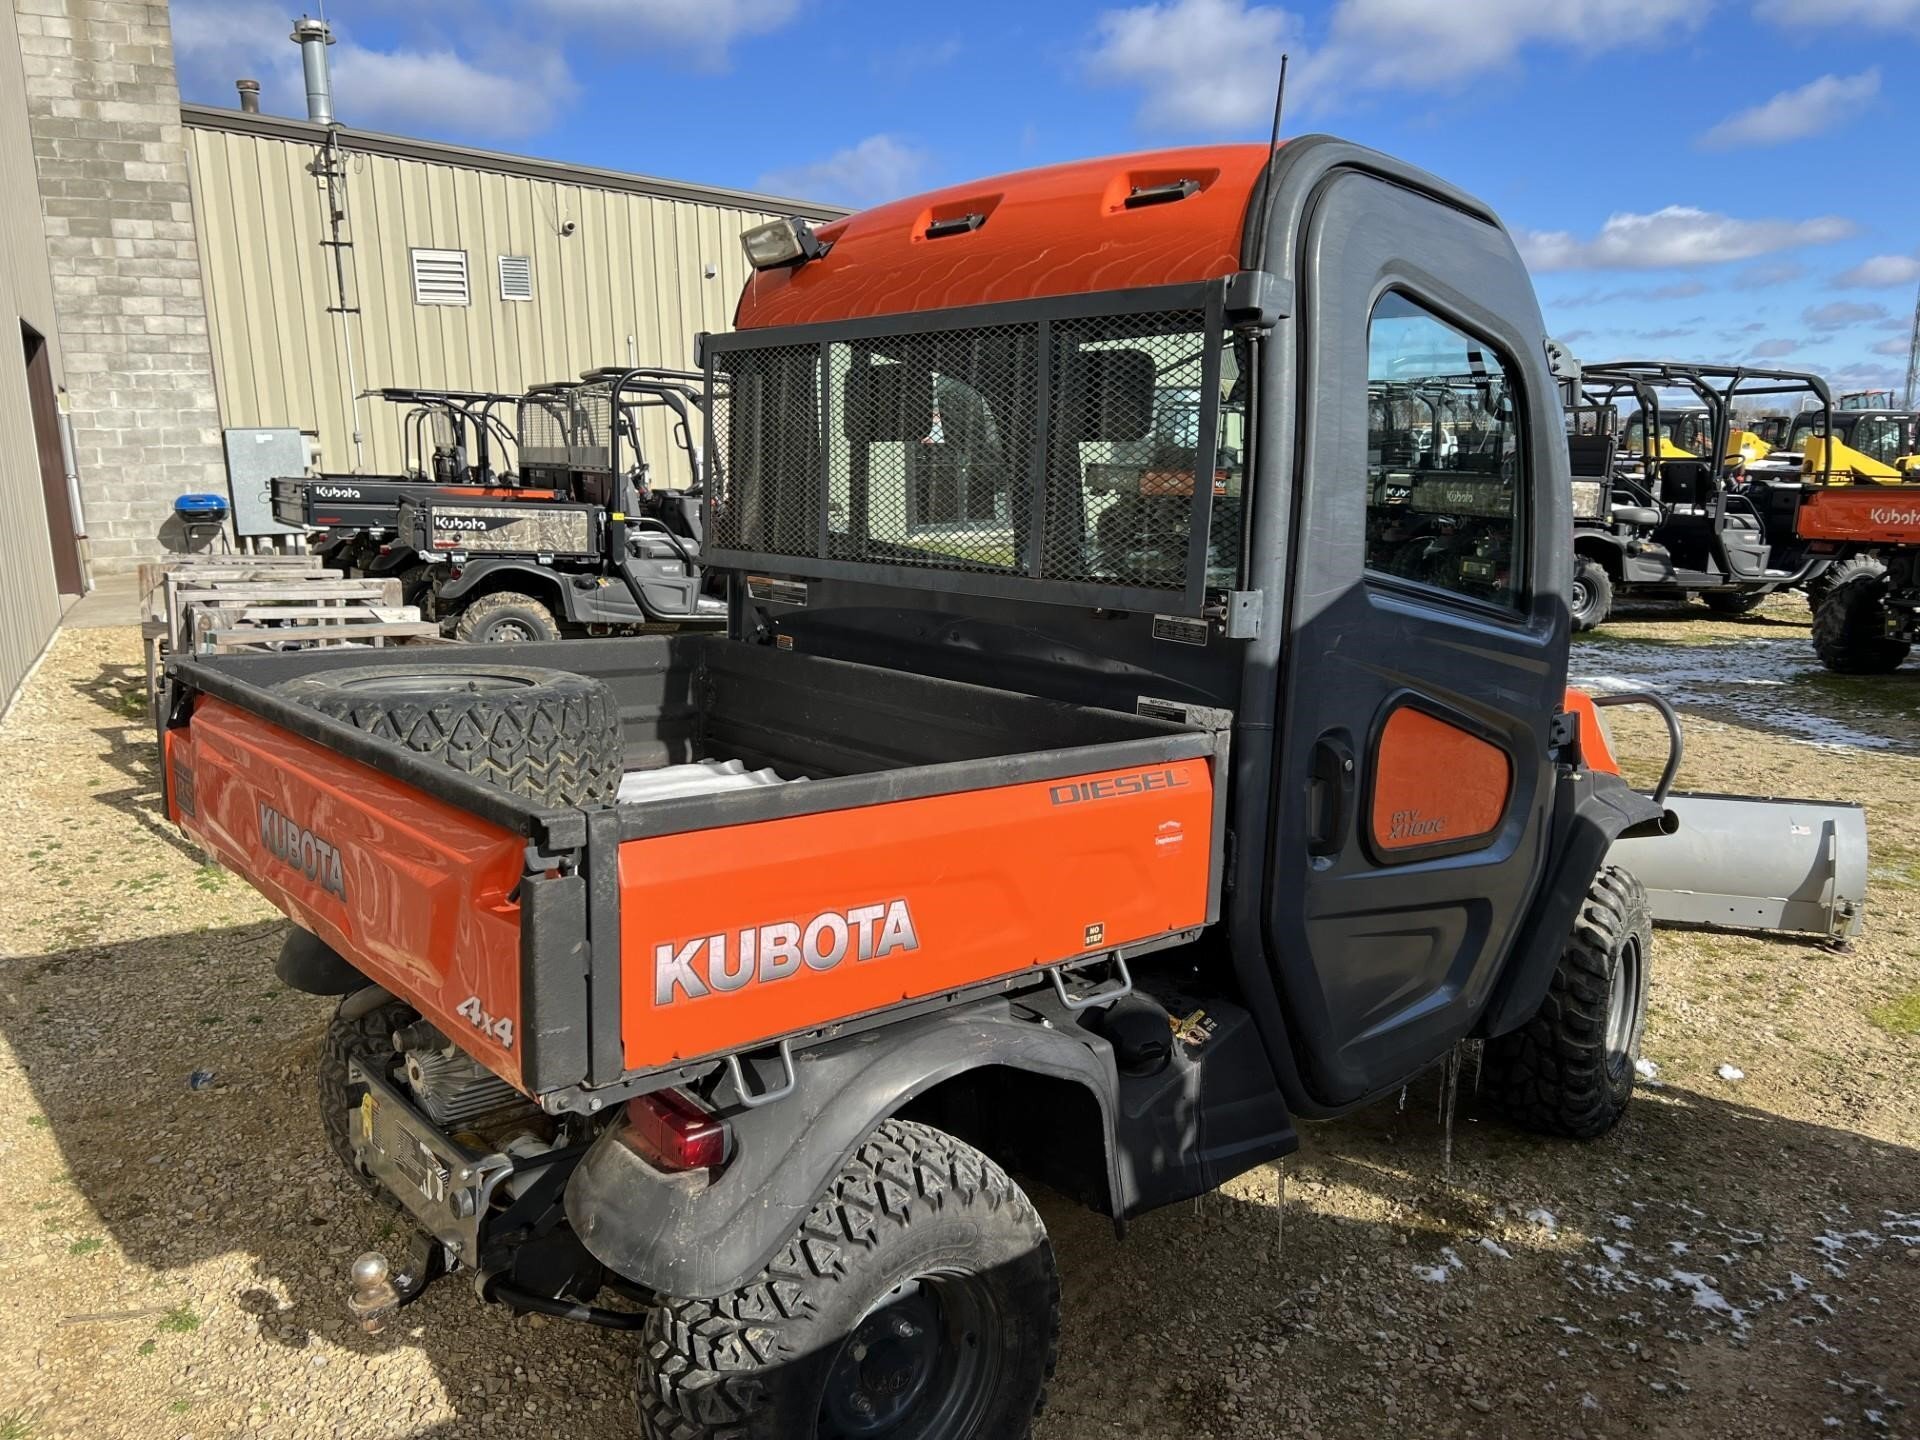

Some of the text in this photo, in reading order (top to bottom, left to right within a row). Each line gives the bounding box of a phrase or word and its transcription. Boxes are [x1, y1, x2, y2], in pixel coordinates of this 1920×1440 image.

[316, 486, 361, 499] Kubota
[435, 516, 487, 531] Kubota
[1049, 768, 1190, 806] DIESEL
[259, 802, 348, 903] KUBOTA
[1086, 933, 1102, 944] STEP
[1089, 926, 1100, 935] NO
[654, 898, 919, 1006] KUBOTA
[455, 996, 515, 1049] 4x4
